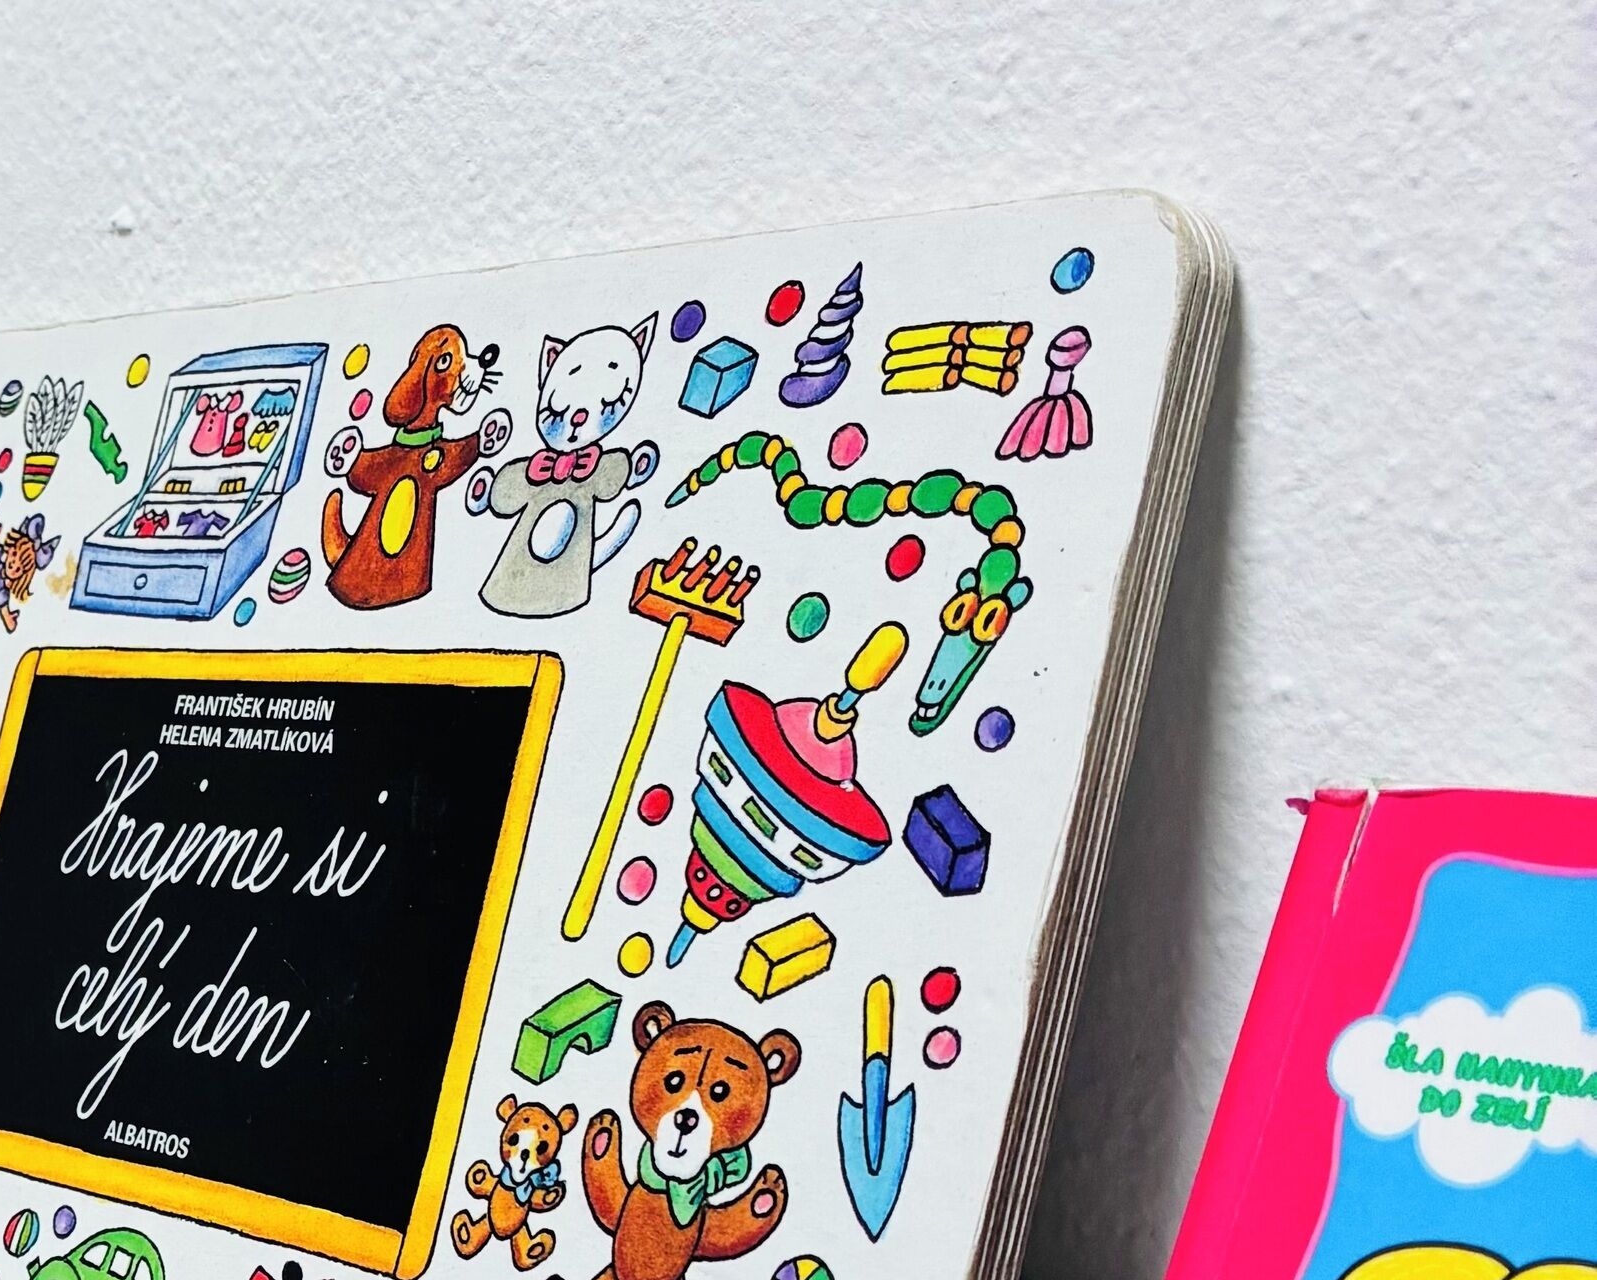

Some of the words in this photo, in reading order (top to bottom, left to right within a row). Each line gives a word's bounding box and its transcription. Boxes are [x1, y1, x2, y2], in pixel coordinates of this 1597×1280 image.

[174, 693, 263, 719] FRANTIŠEK
[266, 696, 335, 721] HRUBÍN
[159, 724, 222, 748] HELENA
[224, 727, 334, 754] ZMATLÍKOVÁ
[60, 748, 290, 954] Hrajeme
[292, 790, 389, 898] si
[55, 917, 191, 1120] celý
[172, 926, 311, 1069] den
[1385, 1031, 1444, 1076] ŠLA
[1418, 1085, 1462, 1118] DO
[104, 1120, 191, 1159] ALBATROS
